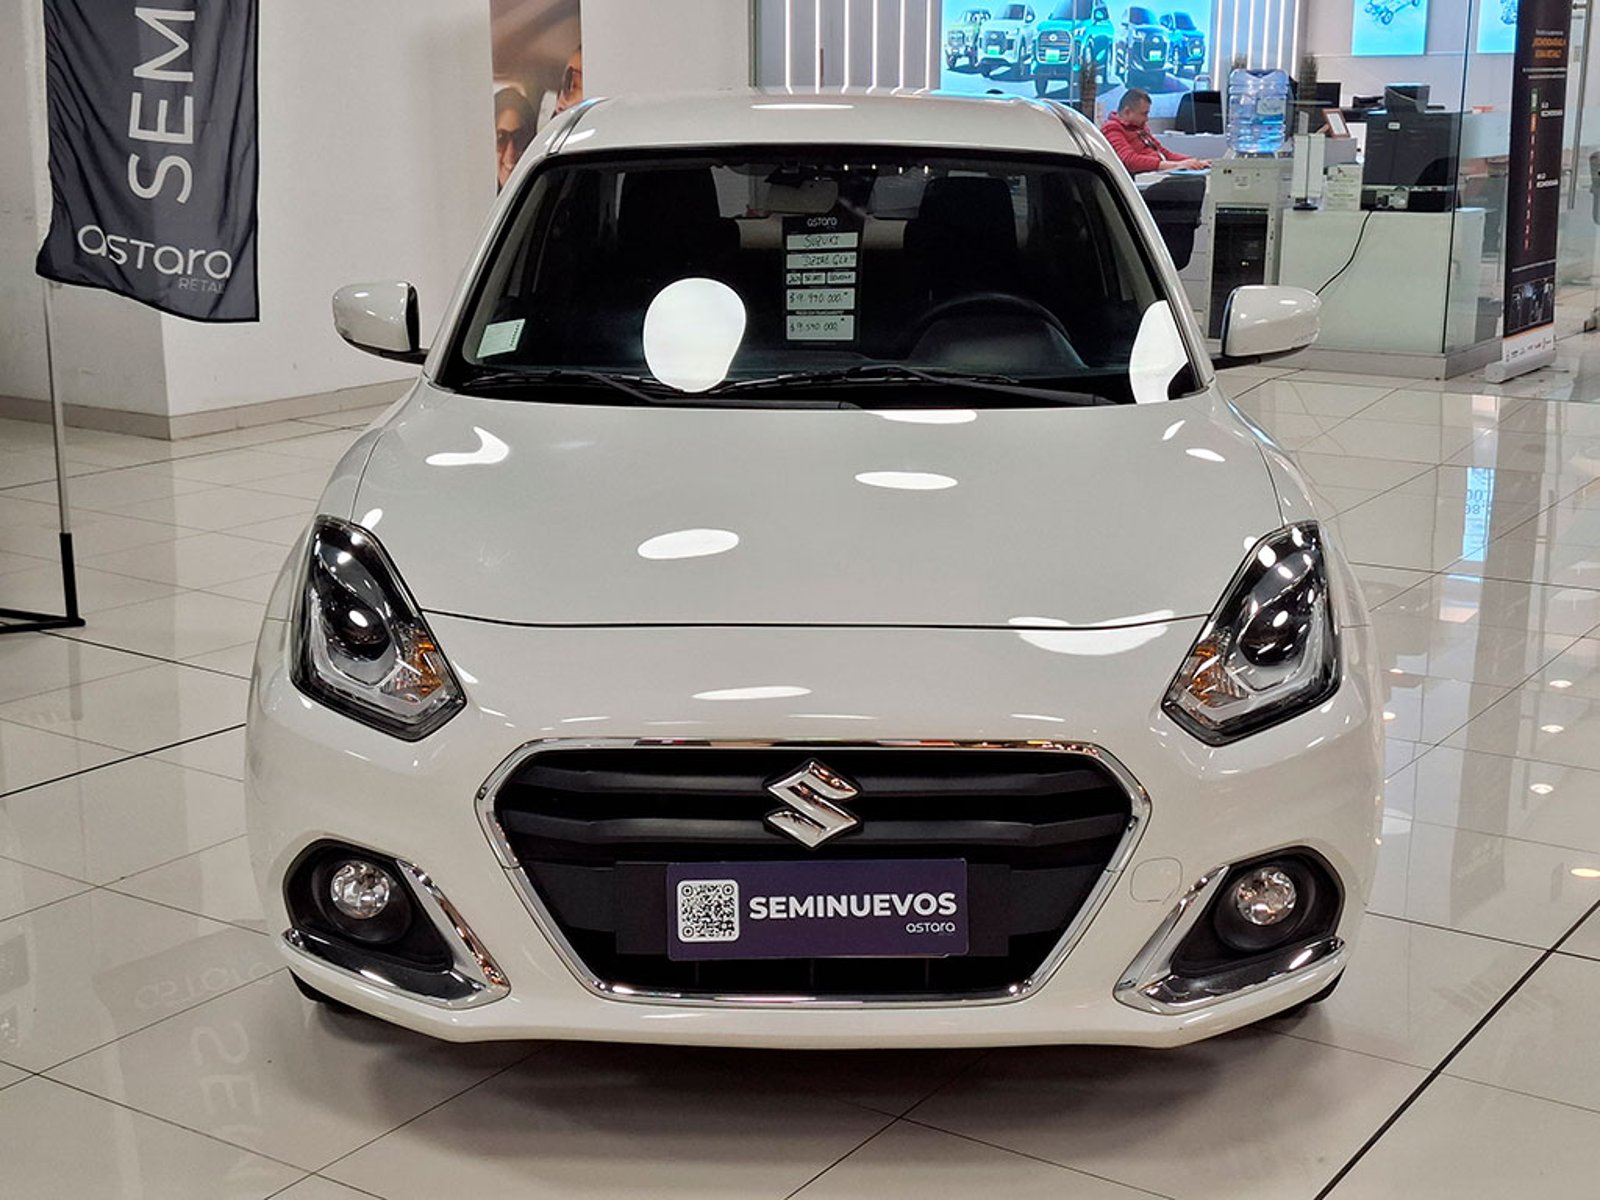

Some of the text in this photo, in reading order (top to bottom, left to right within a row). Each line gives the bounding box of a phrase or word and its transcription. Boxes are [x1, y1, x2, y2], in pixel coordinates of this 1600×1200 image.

[77, 224, 233, 280] astara
[749, 892, 957, 920] SEMINUEVOS
[905, 920, 956, 934] astara
